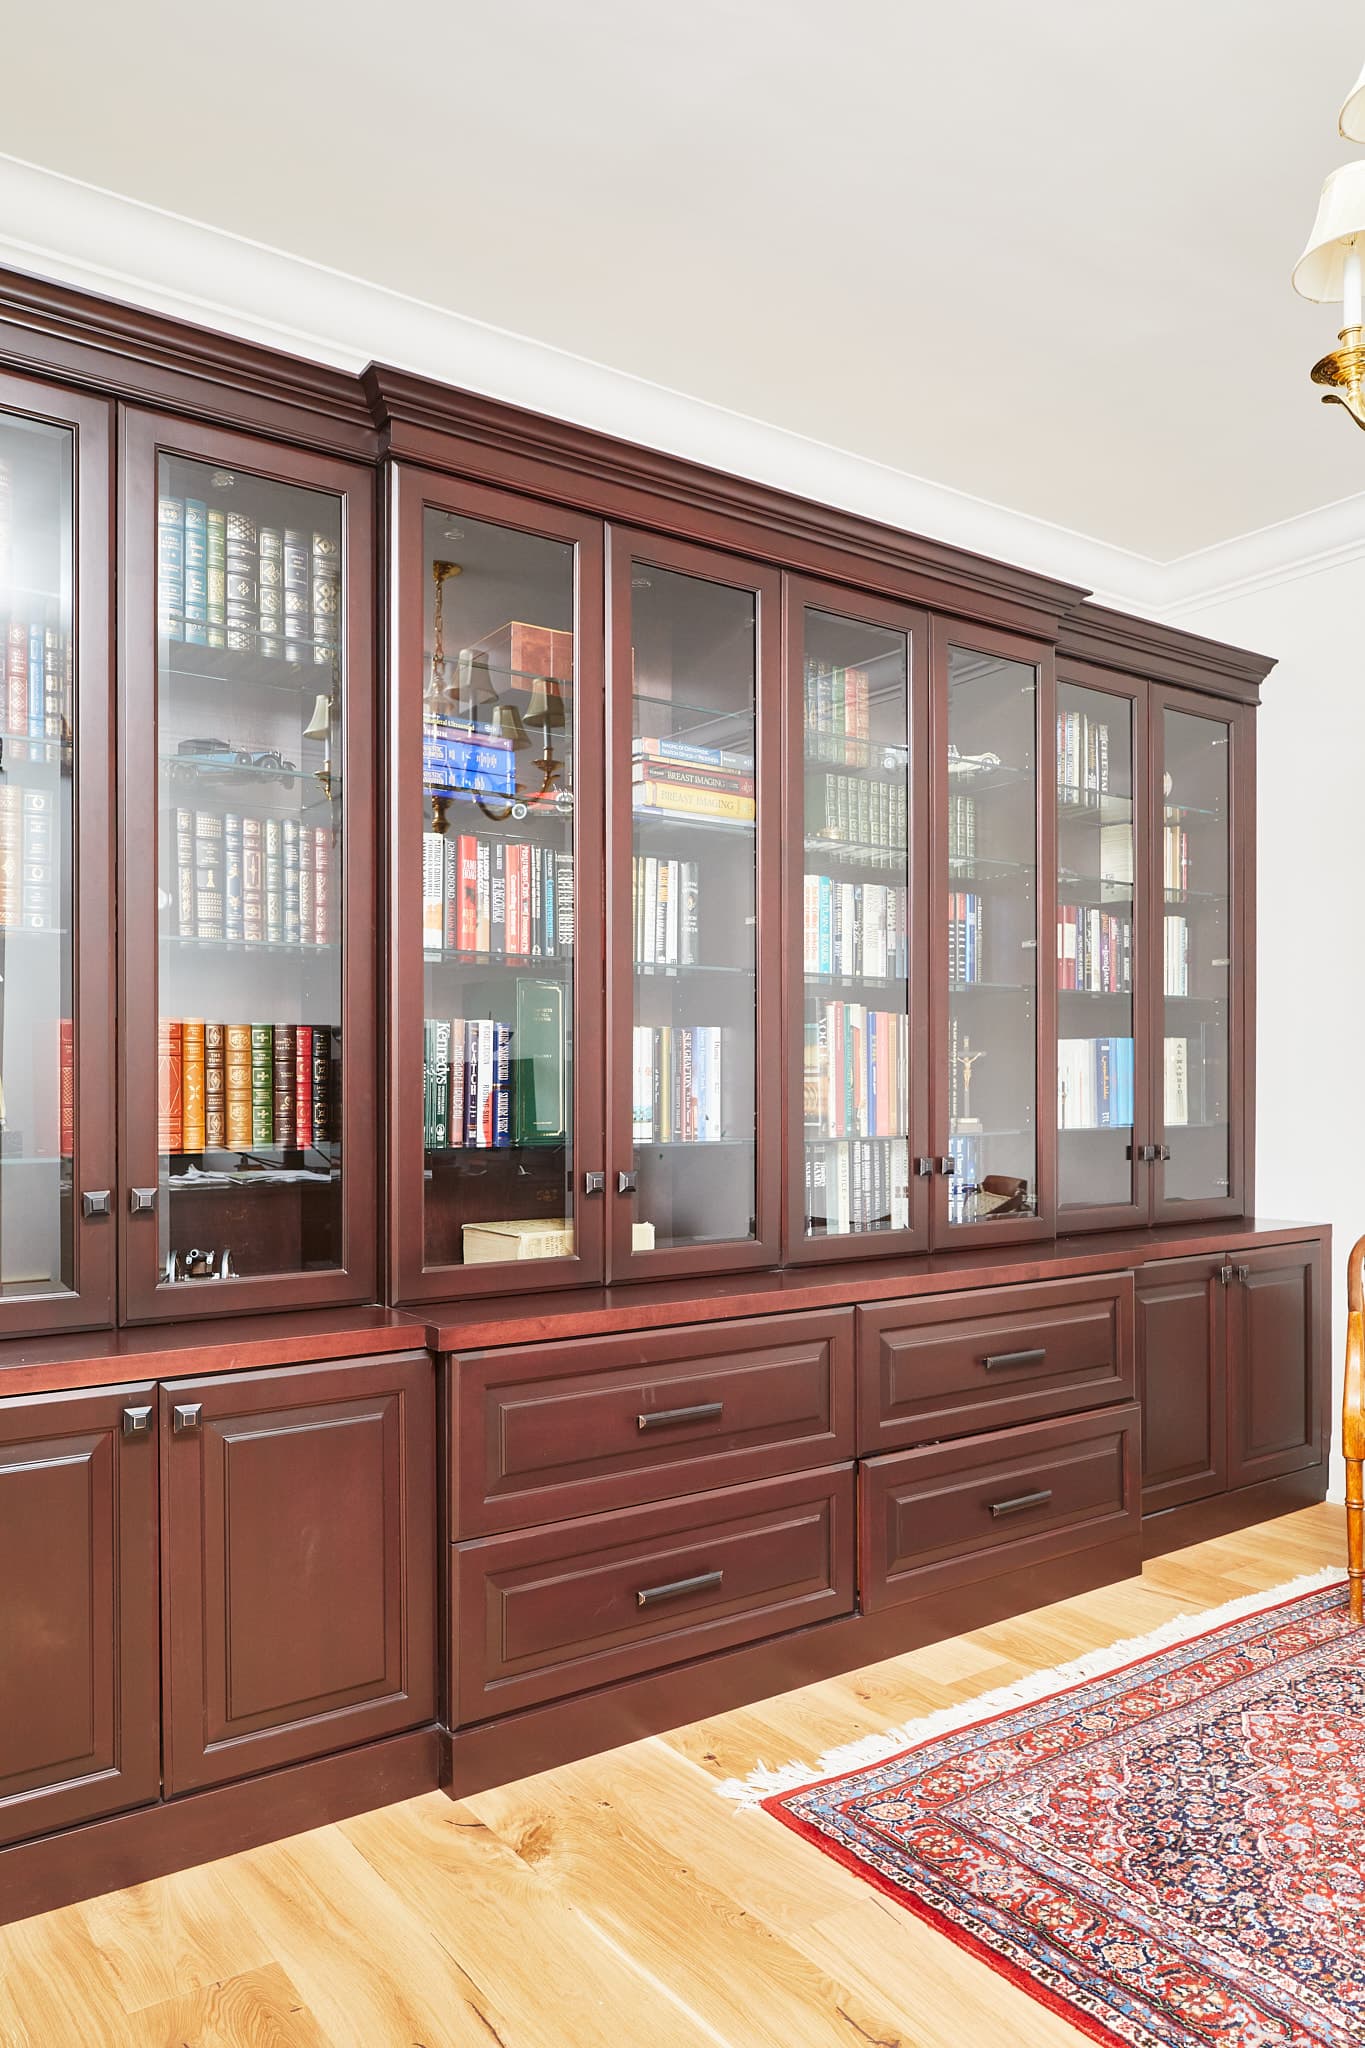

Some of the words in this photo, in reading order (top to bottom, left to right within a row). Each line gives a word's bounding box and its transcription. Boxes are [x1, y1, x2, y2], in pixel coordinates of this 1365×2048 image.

[667, 771, 693, 783] BREAST
[694, 775, 726, 788] IMAGING
[661, 790, 692, 802] BREAST
[696, 795, 736, 810] IMAGING
[447, 841, 456, 860] JOHN
[447, 861, 456, 899] SANDFORD
[498, 1027, 509, 1045] JOHN
[427, 1022, 450, 1084] Kennedys
[453, 1045, 463, 1084] MARGARET
[498, 1046, 509, 1081] SANDFORD
[453, 1087, 463, 1119] TRUDEAU
